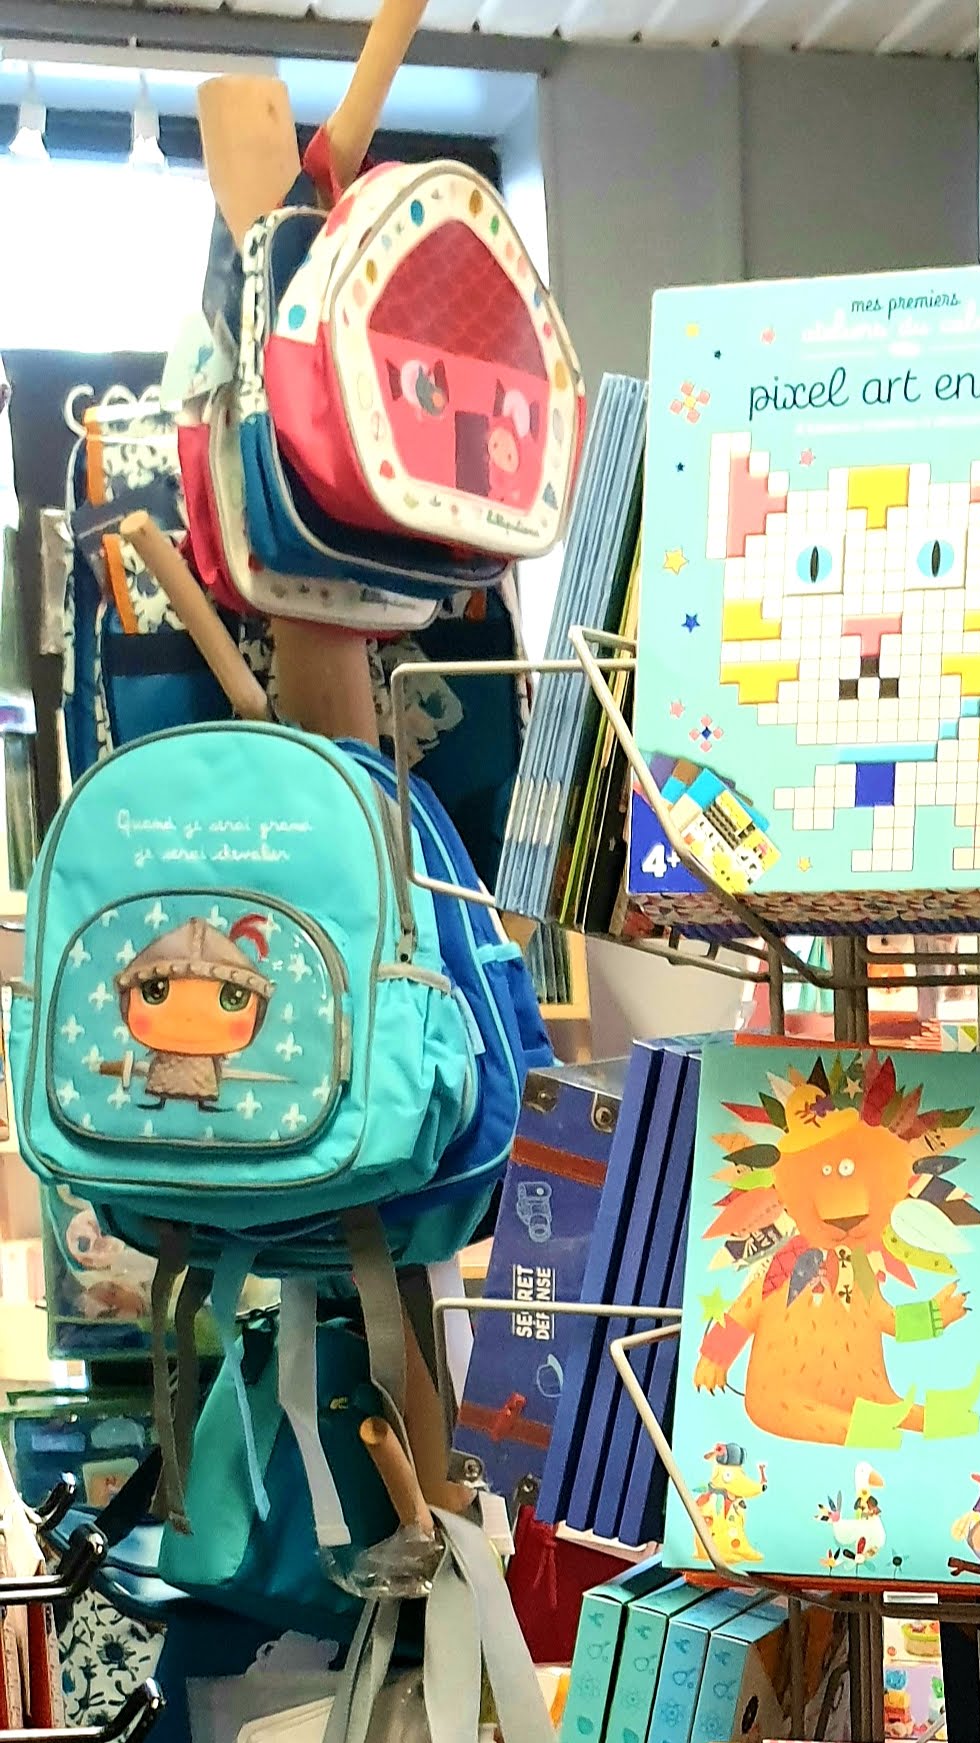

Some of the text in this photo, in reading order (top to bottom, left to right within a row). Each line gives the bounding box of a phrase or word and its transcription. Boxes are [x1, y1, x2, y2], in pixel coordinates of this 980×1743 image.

[851, 289, 961, 319] mes premiers
[749, 367, 849, 422] pixel
[862, 368, 921, 406] art
[641, 842, 681, 878] 4+
[516, 1264, 534, 1338] SERET
[534, 1267, 551, 1340] DÉFNSE
